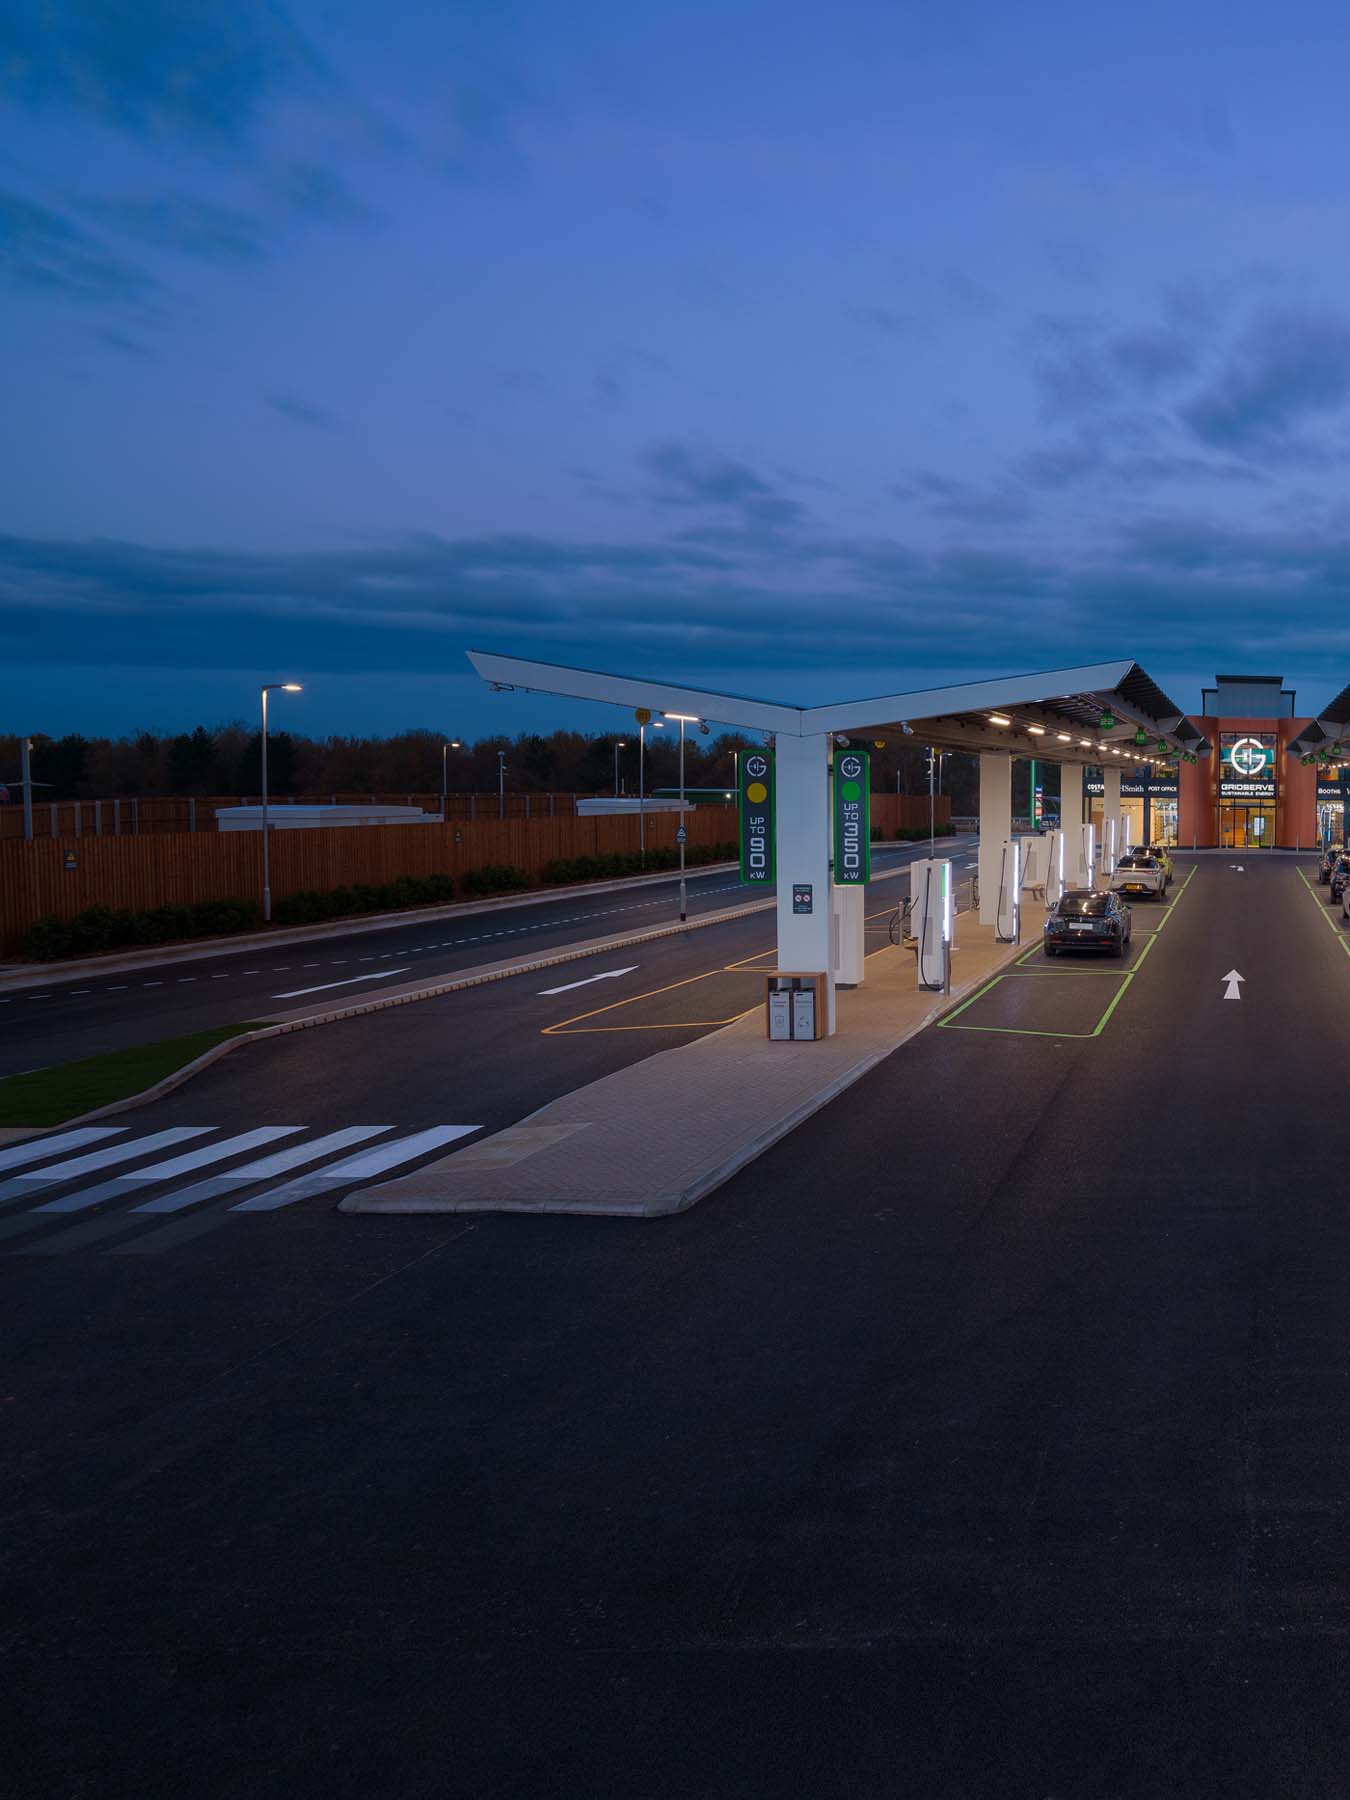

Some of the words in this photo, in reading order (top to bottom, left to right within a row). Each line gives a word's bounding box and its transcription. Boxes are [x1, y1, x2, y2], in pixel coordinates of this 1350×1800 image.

[1221, 783, 1275, 791] GRIDSERVE
[844, 803, 859, 811] UP
[844, 812, 859, 820] TO
[750, 817, 765, 825] UP
[750, 826, 765, 834] TO
[844, 822, 859, 868] 350
[749, 837, 766, 868] 90
